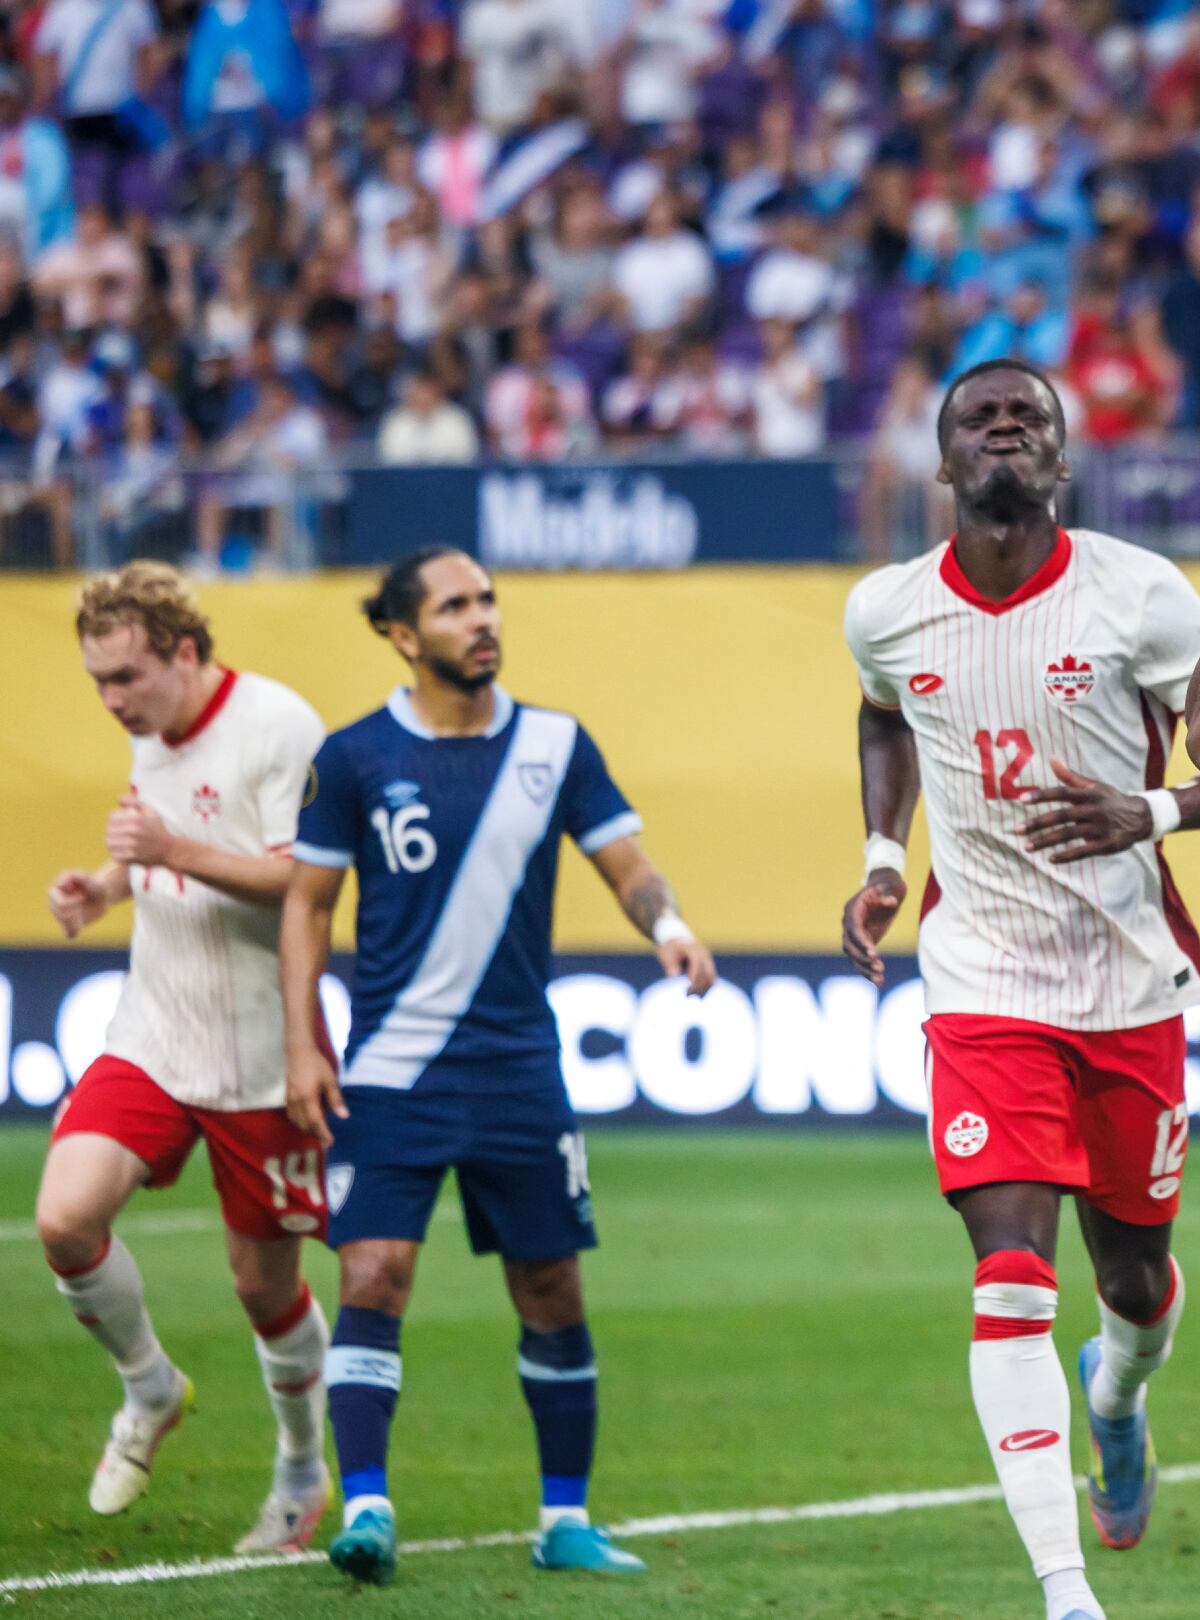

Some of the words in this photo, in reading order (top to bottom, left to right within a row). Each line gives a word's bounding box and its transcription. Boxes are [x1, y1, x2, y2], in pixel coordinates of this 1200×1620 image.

[1044, 674, 1095, 684] CANADA
[974, 728, 1040, 800] 12
[371, 803, 438, 874] 16
[1150, 1101, 1189, 1177] 12
[263, 1149, 324, 1210] 14
